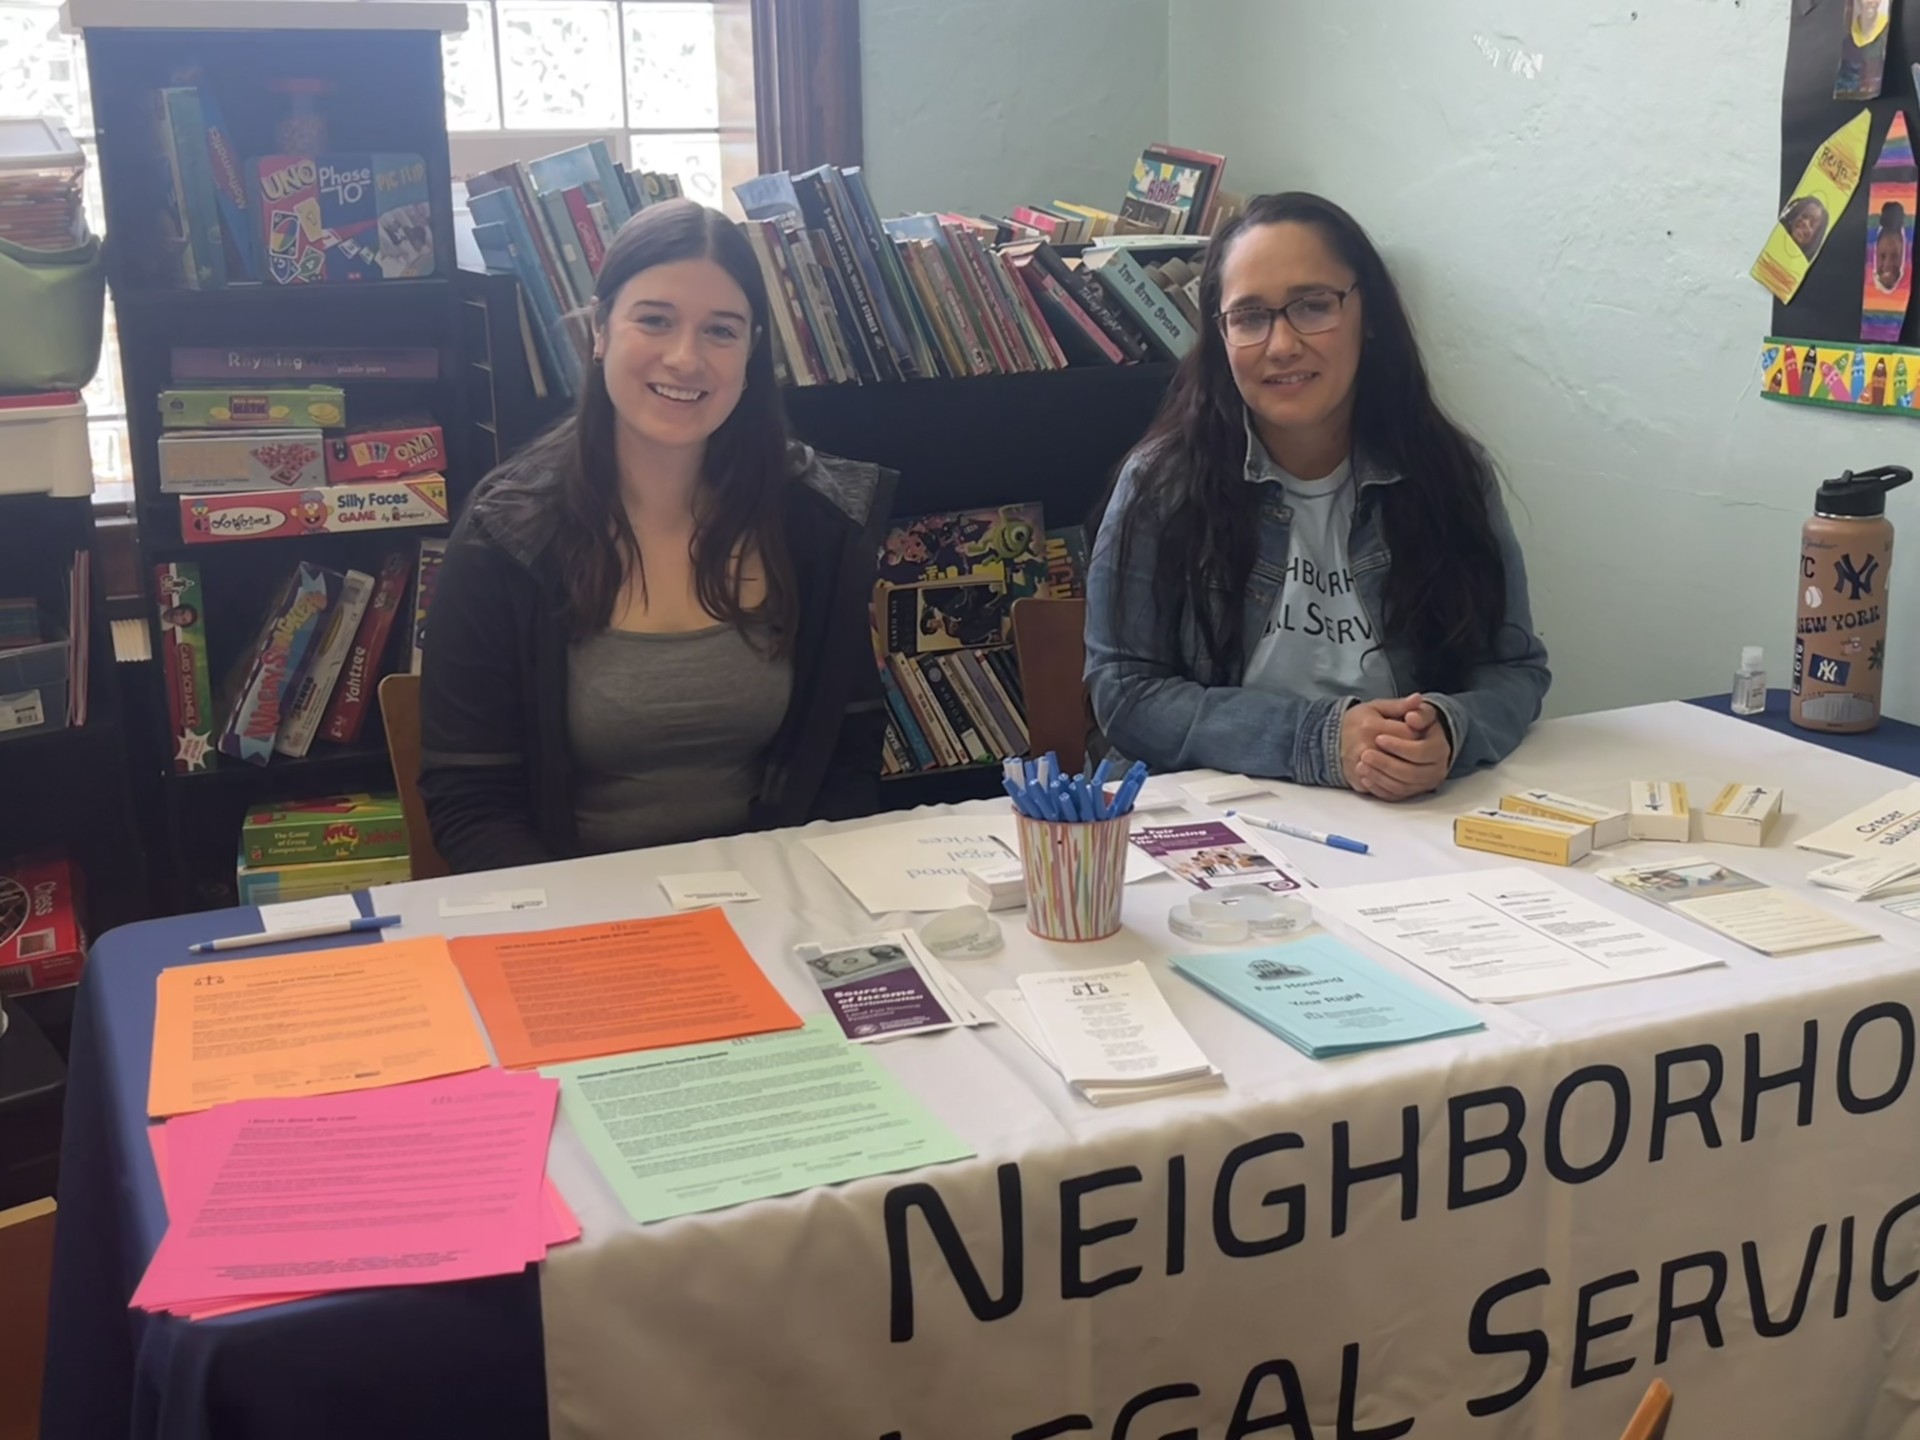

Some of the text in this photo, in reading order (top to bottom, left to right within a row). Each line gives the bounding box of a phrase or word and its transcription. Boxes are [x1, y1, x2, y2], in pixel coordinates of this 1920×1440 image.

[262, 159, 317, 202] UNO
[319, 166, 371, 188] Phase
[338, 182, 363, 205] 10
[228, 351, 303, 370] Rhyming
[394, 431, 436, 461] UNO
[407, 450, 439, 468] GIANT
[337, 492, 409, 510] Silly Faces
[337, 510, 377, 525] GAME
[1798, 605, 1881, 635] NEW YORK
[345, 646, 367, 704] Yahtzee
[1856, 810, 1906, 834] Crecer
[918, 836, 992, 847] rvices
[34, 880, 57, 915] Chess
[834, 986, 888, 998] Source
[1255, 976, 1345, 993] Fair Housing
[857, 989, 916, 1001] Income
[1323, 992, 1365, 1006] Right
[884, 1001, 1916, 1343] NEIGHBORHO
